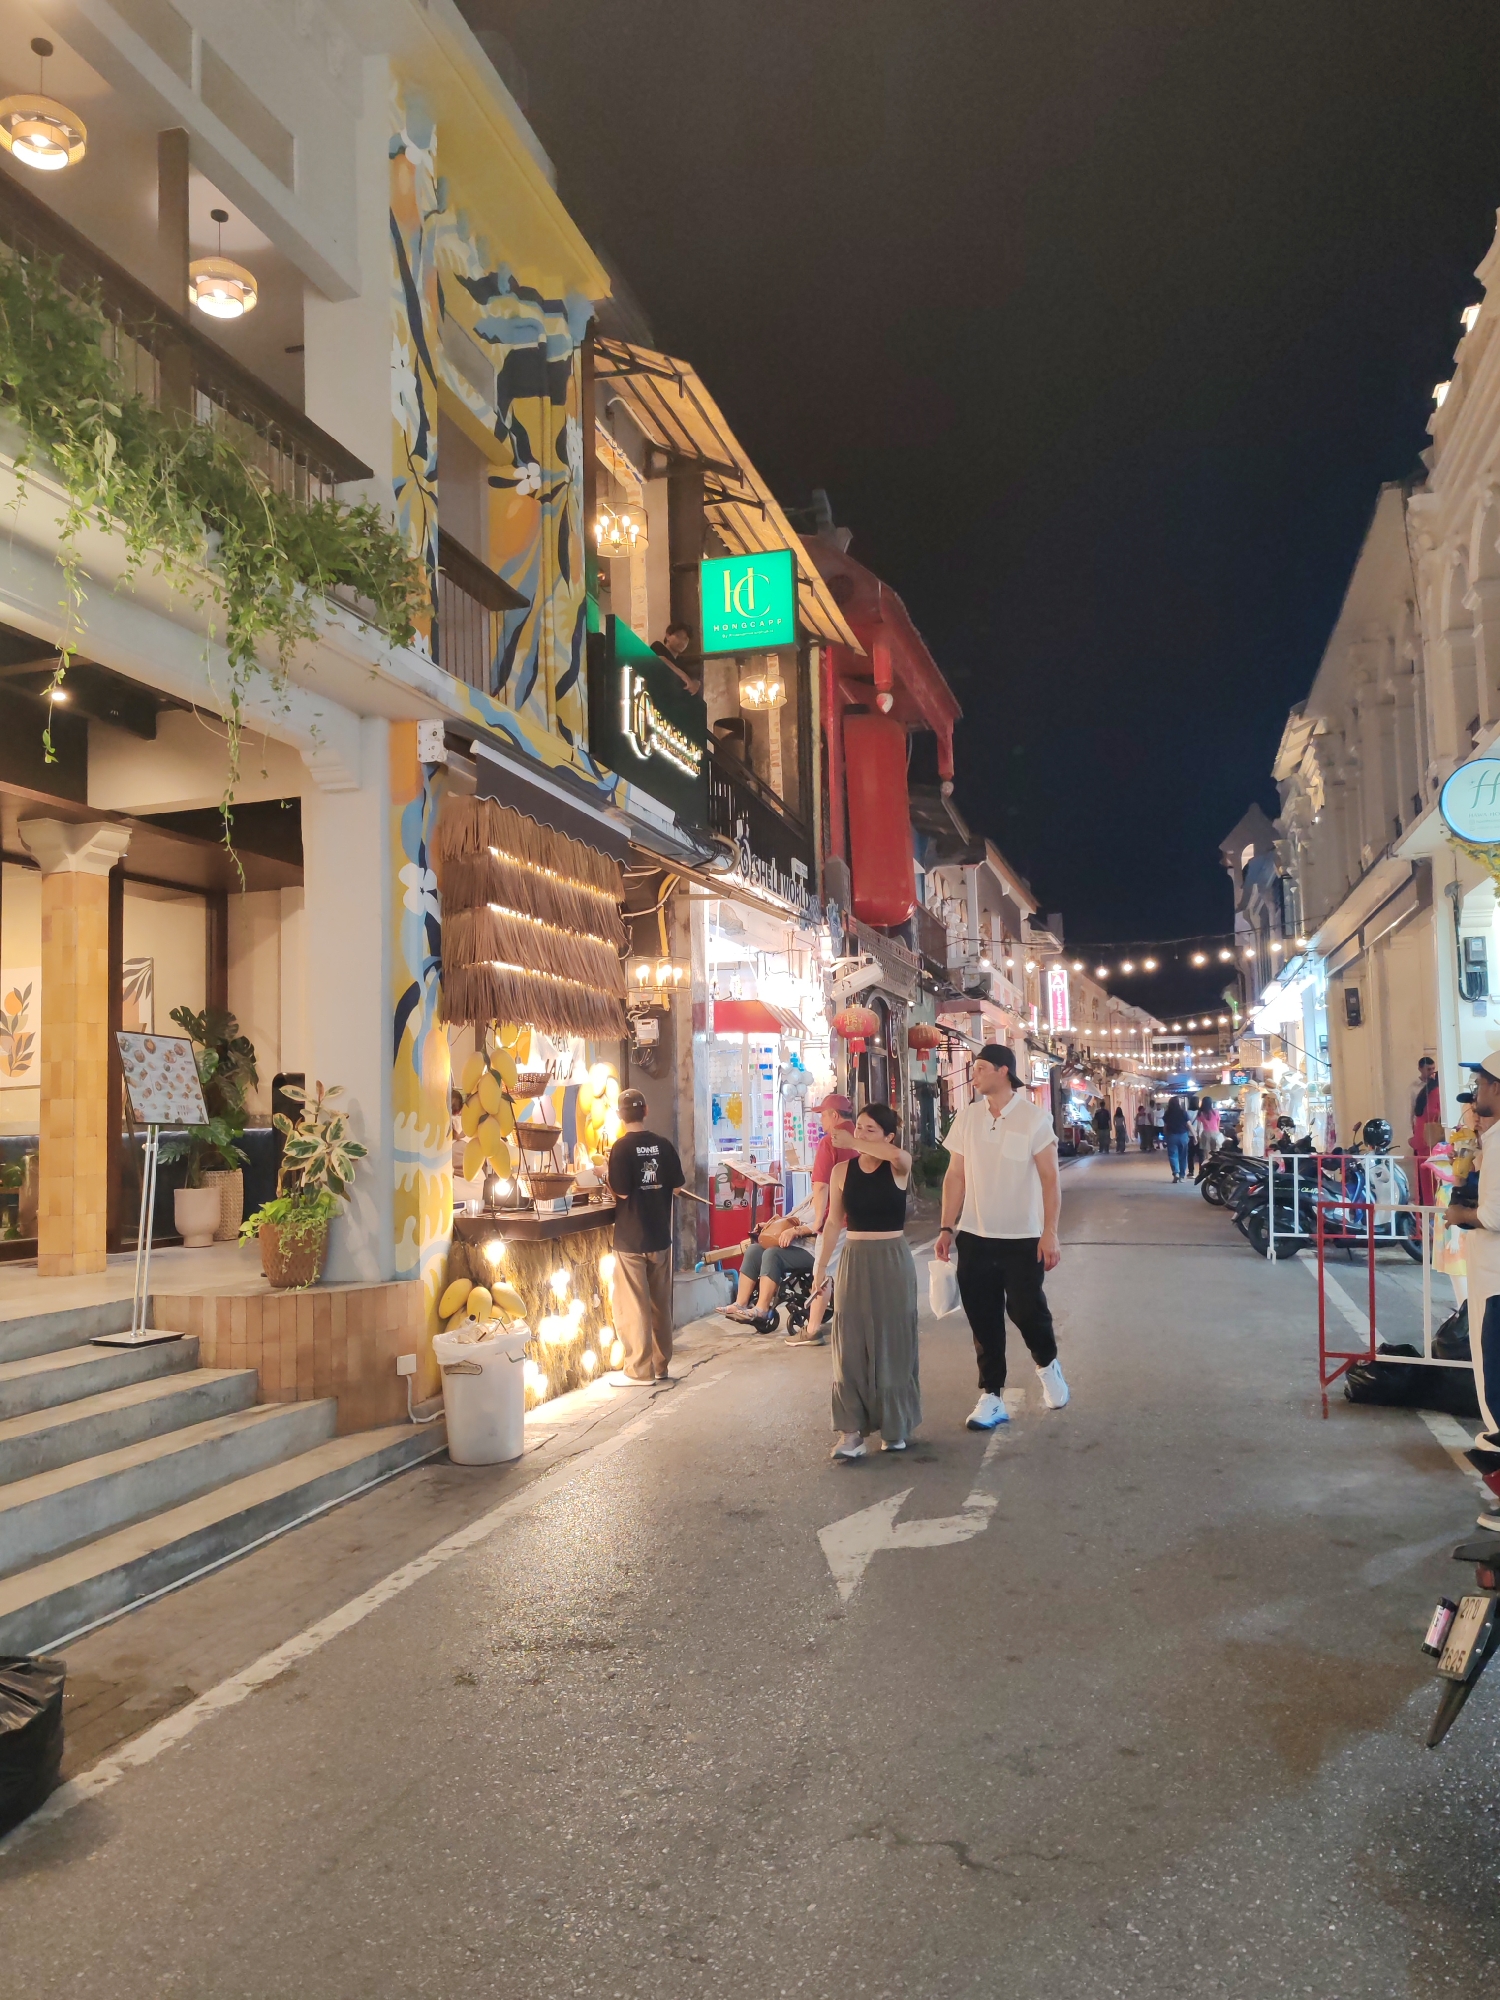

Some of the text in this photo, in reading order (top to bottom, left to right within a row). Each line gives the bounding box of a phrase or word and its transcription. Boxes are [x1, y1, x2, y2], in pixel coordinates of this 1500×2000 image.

[713, 618, 782, 632] HONGCAPP
[754, 857, 811, 911] SHELL WORLD
